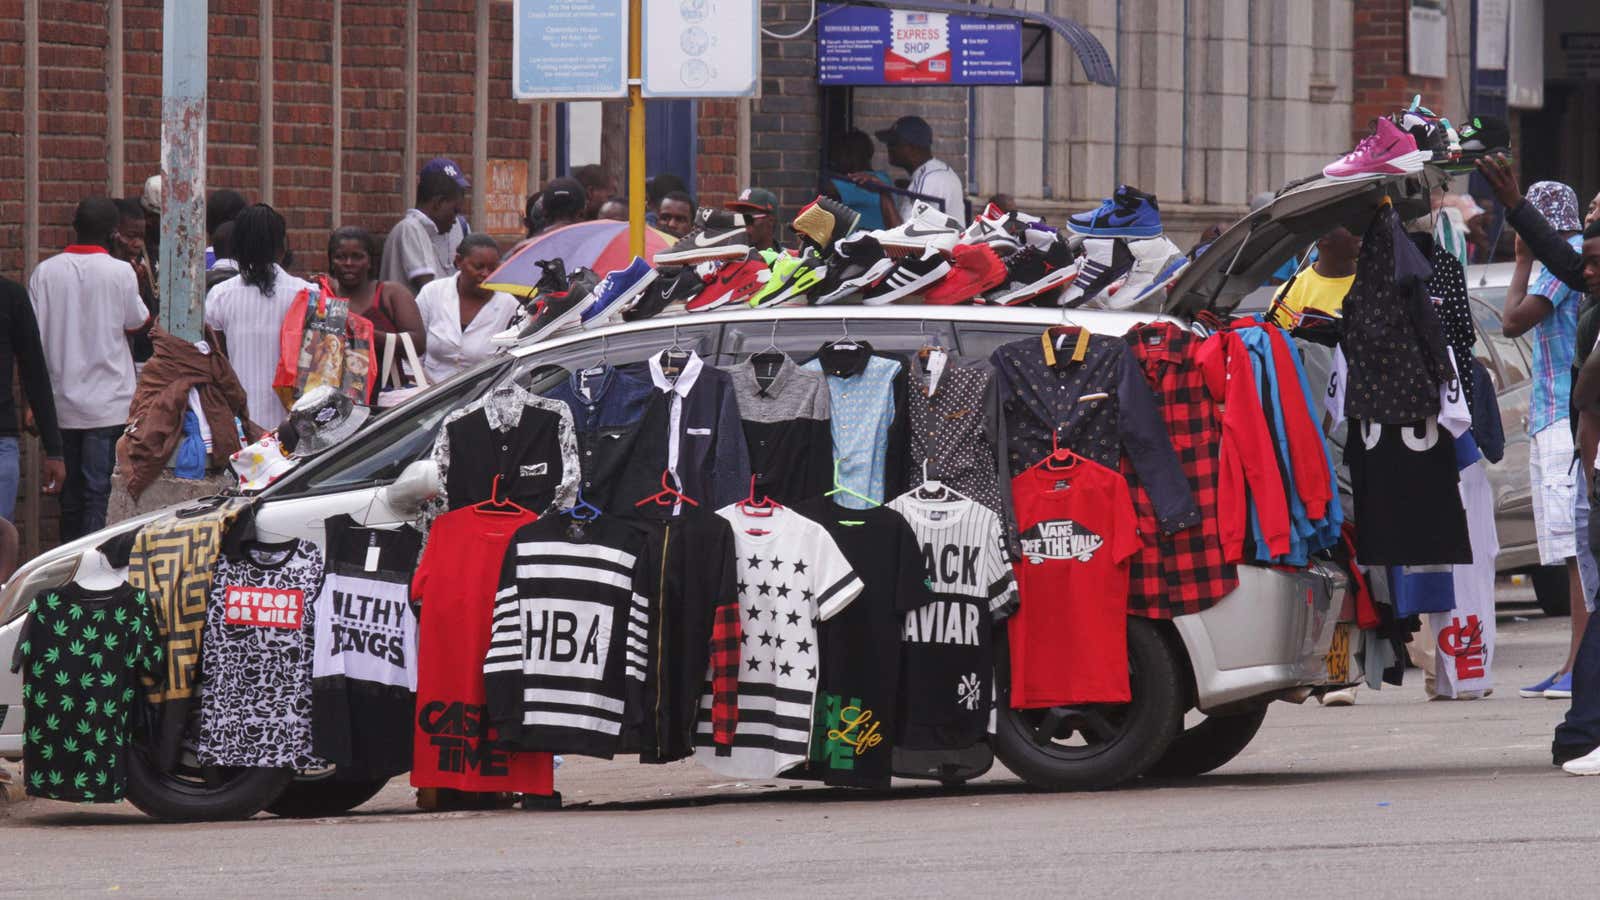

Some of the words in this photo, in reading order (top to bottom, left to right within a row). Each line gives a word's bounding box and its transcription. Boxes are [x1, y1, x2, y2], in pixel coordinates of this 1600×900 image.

[896, 29, 940, 40] EXPRESS
[904, 42, 930, 54] SHOP
[1447, 377, 1460, 403] 9
[1037, 520, 1073, 537] VANS
[1042, 536, 1070, 556] THE
[917, 543, 981, 587] ACK
[229, 590, 298, 609] PETROL
[228, 606, 253, 621] OR
[258, 608, 297, 624] MILK
[900, 601, 980, 646] AVIAR
[526, 610, 600, 665] HBA
[418, 701, 496, 738] CAS
[828, 706, 883, 755] Life
[430, 736, 509, 776] TIME
